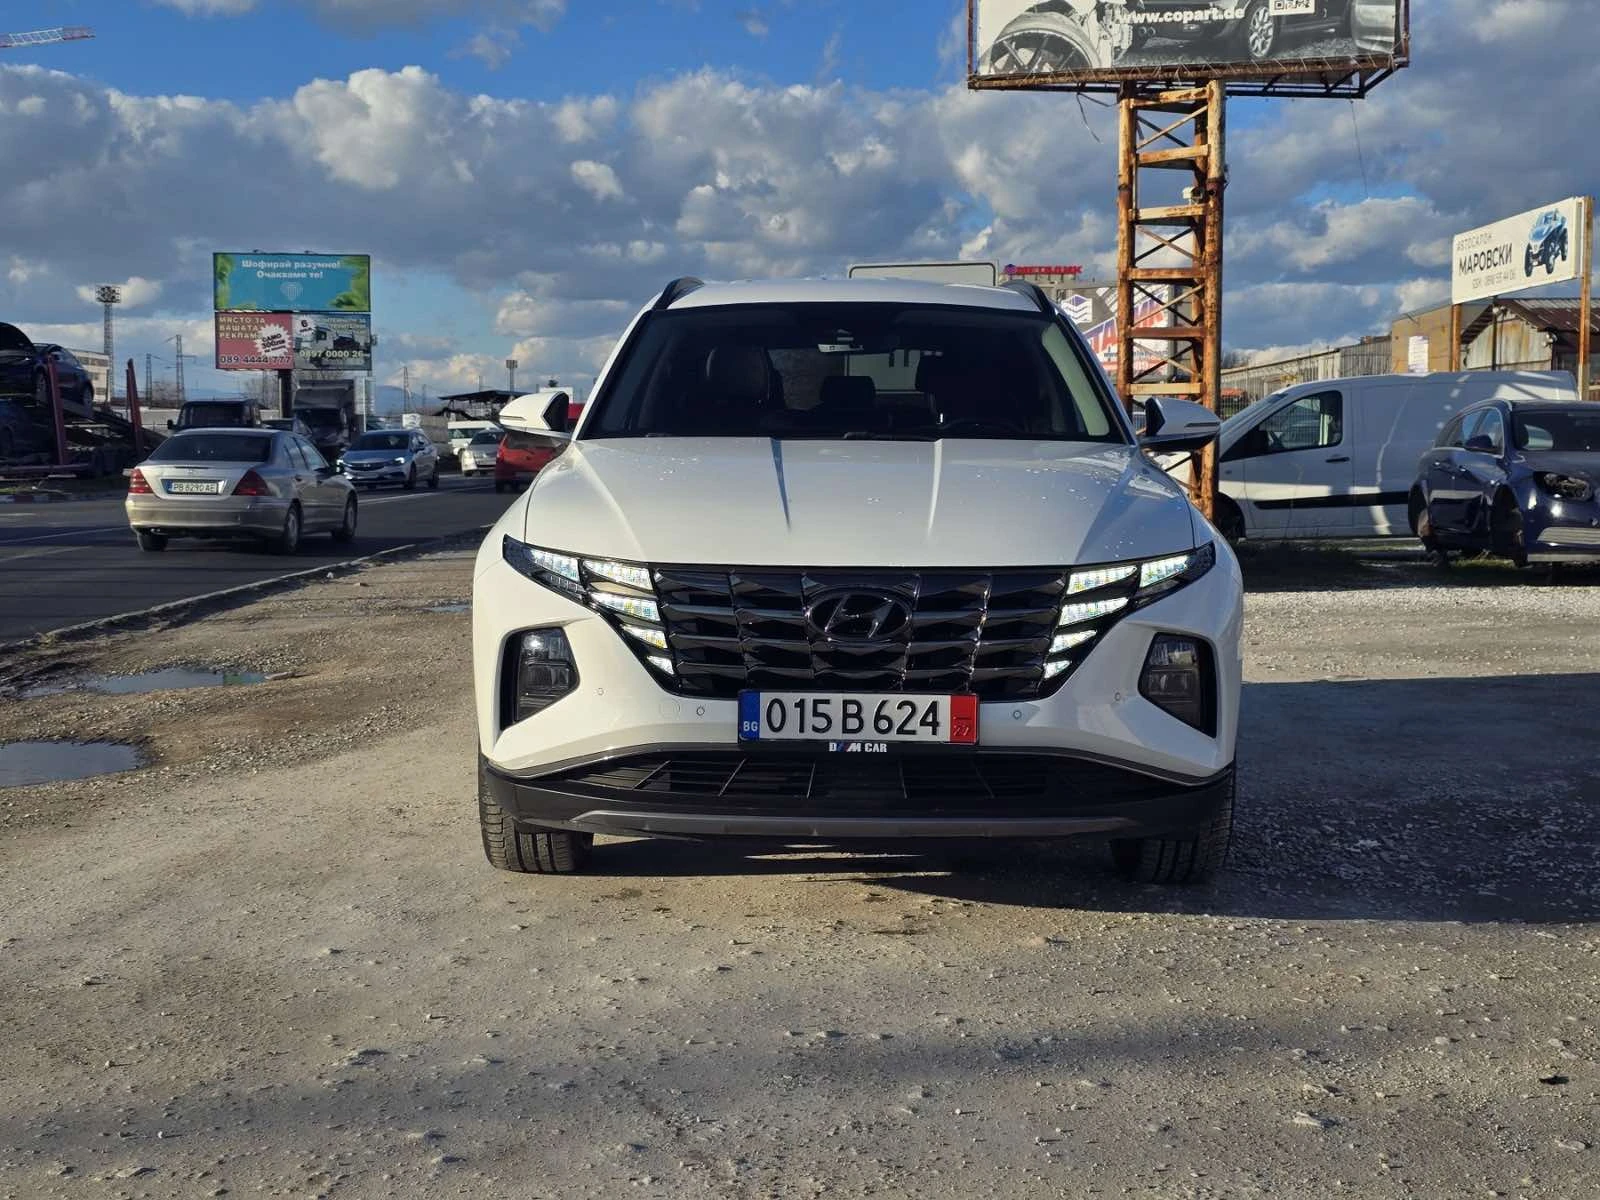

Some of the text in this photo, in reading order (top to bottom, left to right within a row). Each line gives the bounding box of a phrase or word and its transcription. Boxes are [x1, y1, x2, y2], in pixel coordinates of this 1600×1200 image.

[1120, 7, 1245, 24] www.copart.de
[1459, 242, 1513, 276] МАРОВСКИ
[241, 260, 341, 270] Шофирай разумно!
[219, 316, 252, 324] МЯСТО
[219, 324, 259, 332] ВАШАТА
[242, 354, 269, 364] 4444
[271, 355, 291, 364] 777
[743, 720, 758, 732] BG
[864, 742, 887, 752] CAR
